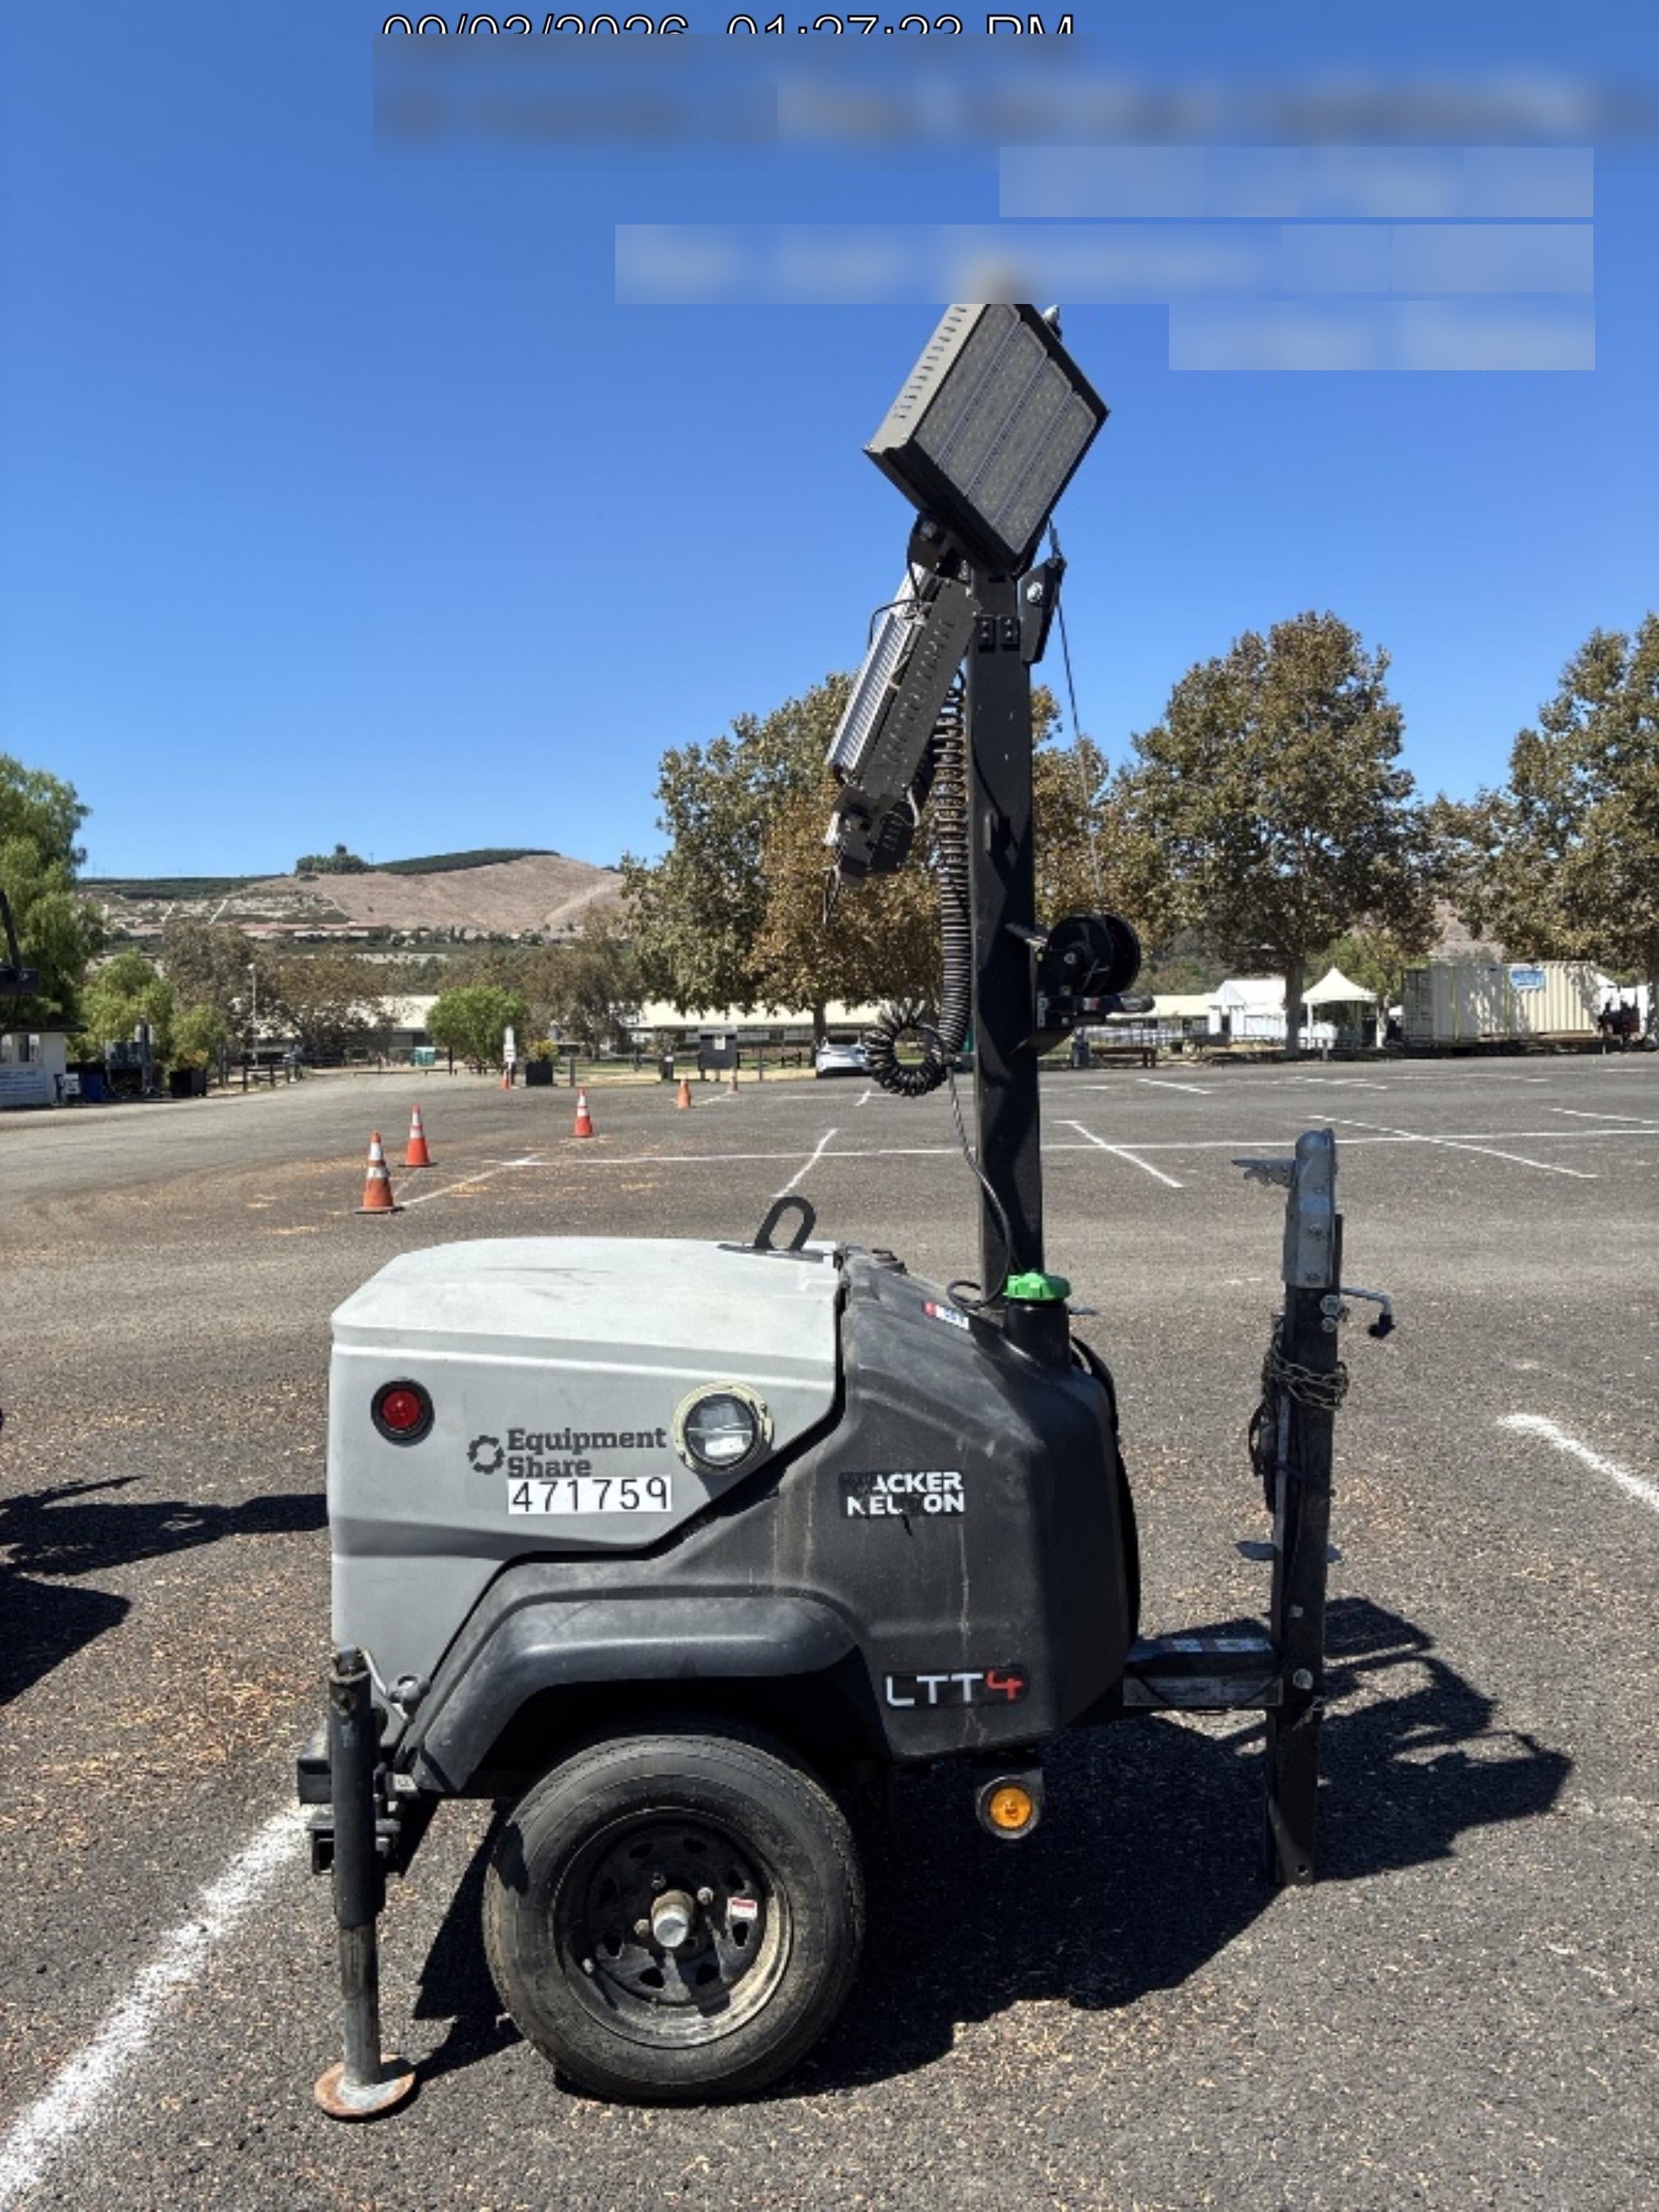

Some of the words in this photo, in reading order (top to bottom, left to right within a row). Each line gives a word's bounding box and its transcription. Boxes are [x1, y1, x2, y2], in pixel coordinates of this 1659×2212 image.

[506, 1428, 667, 1455] Equipment
[506, 1456, 592, 1478] Share
[512, 1476, 668, 1512] 471759
[872, 1471, 964, 1494] ACKER
[846, 1492, 965, 1516] NEUON
[885, 1670, 1023, 1706] LTT4
